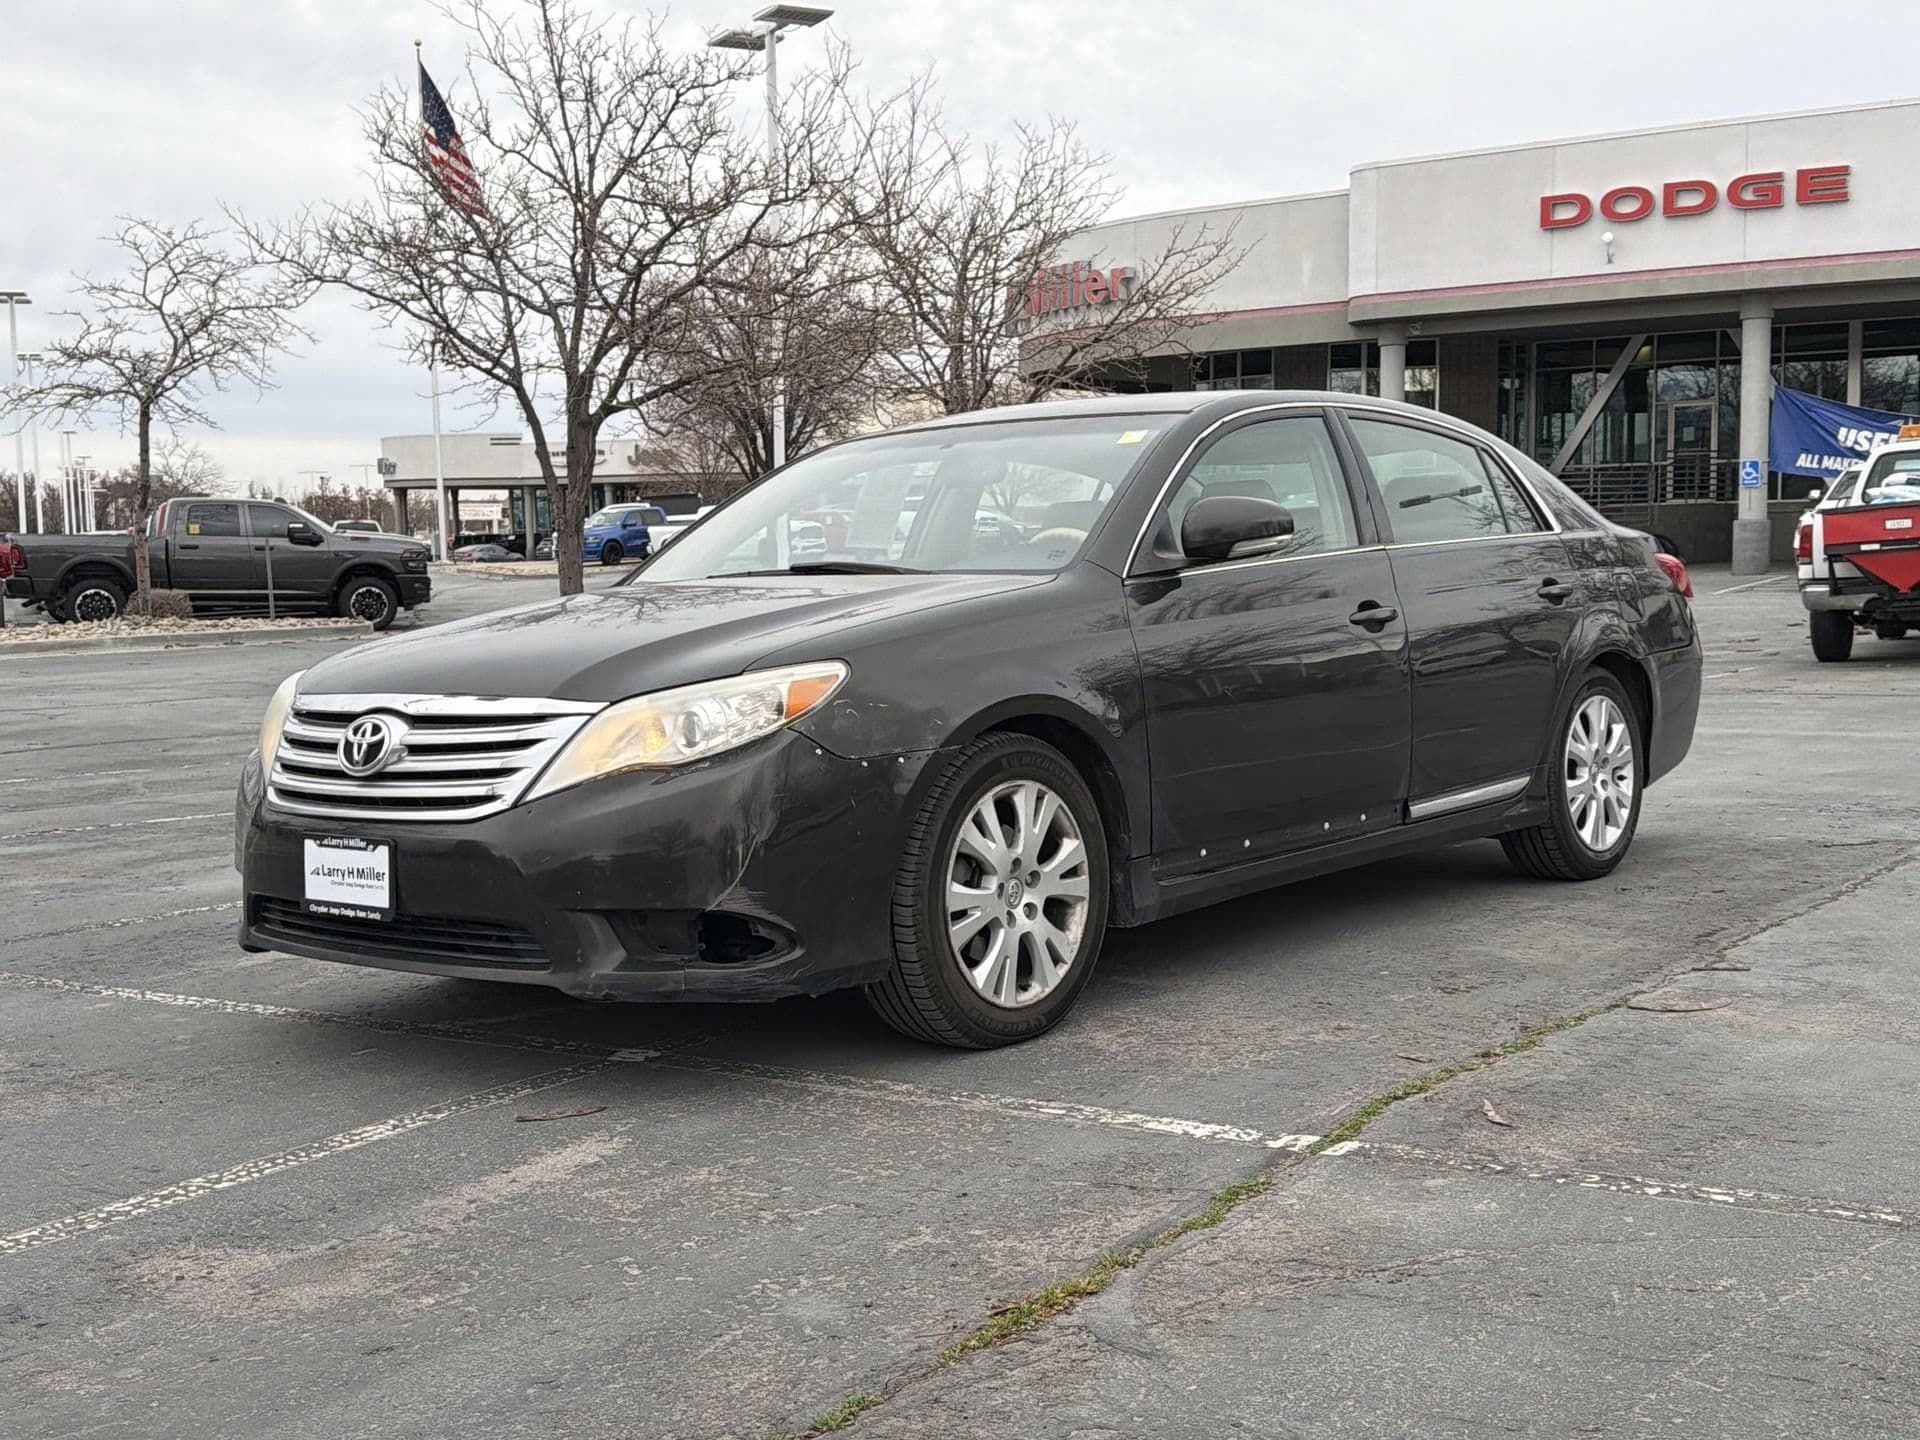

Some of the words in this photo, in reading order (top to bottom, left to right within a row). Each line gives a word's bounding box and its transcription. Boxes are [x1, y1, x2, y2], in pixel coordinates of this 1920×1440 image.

[1540, 165, 1851, 231] DODGE
[1838, 426, 1898, 452] USE
[1795, 453, 1820, 469] ALL
[321, 864, 346, 881] Larry
[347, 866, 355, 879] H
[356, 866, 386, 882] Miller
